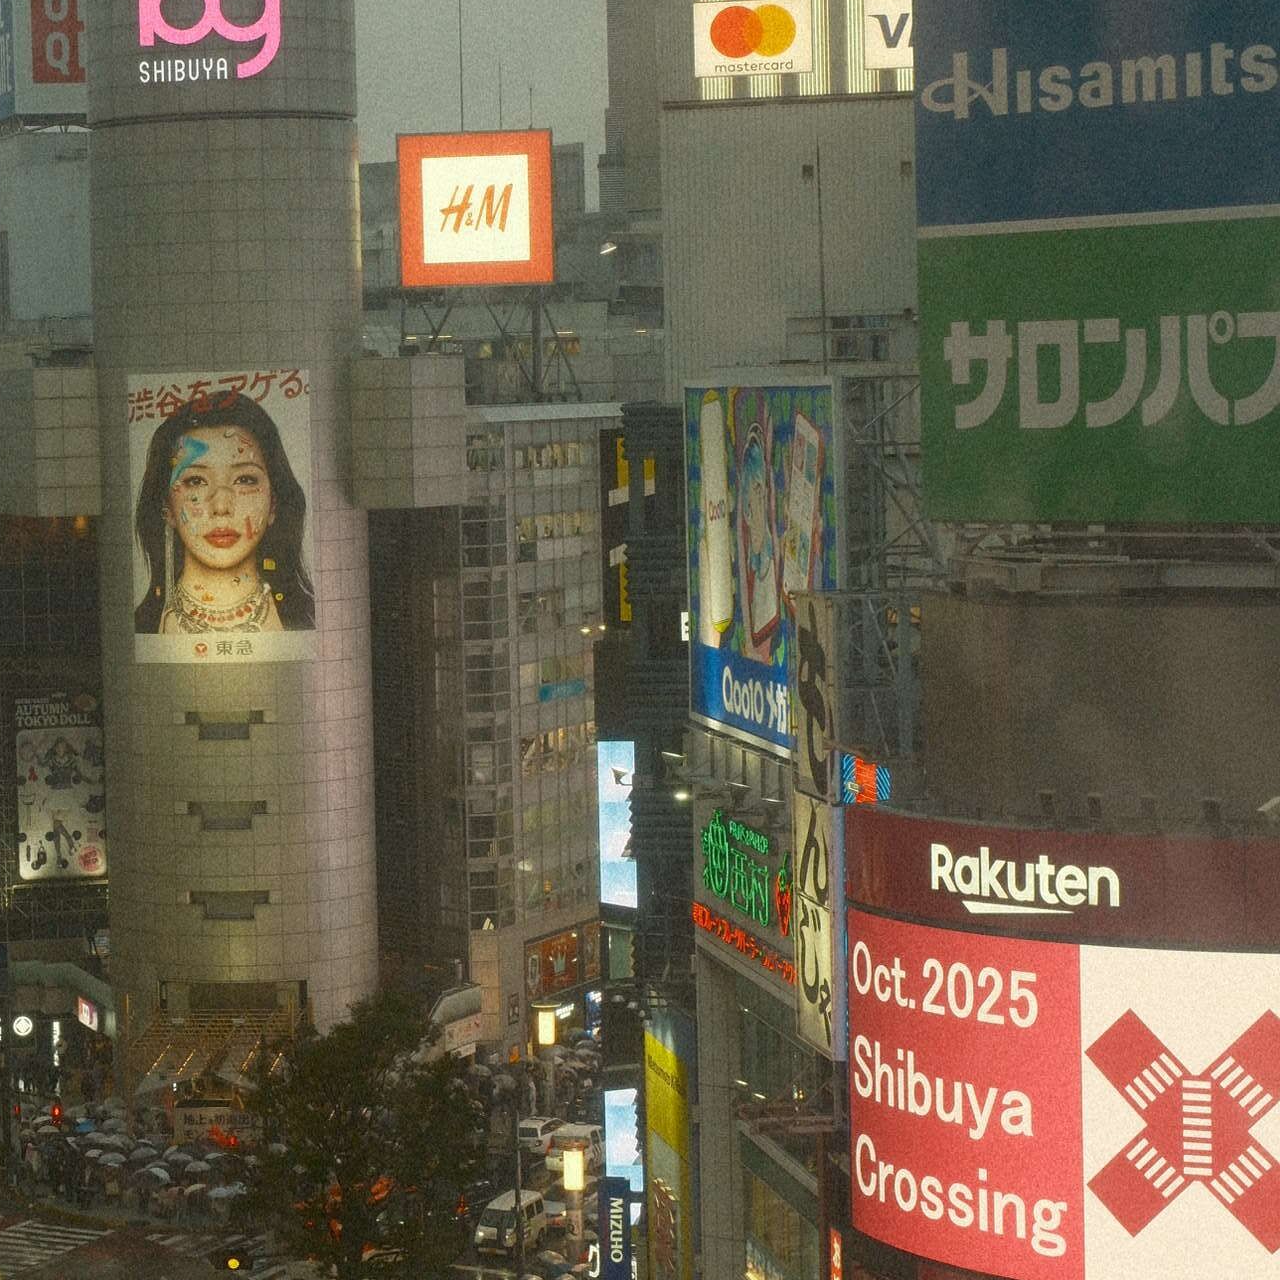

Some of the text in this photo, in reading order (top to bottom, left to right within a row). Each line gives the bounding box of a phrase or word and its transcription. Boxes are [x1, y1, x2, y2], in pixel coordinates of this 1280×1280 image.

[138, 57, 228, 84] SHIBUYA
[713, 58, 794, 76] mastercard
[439, 182, 513, 234] H&M
[127, 369, 311, 424] 渋谷をアゲる。
[215, 639, 255, 657] 東急
[16, 703, 69, 717] AUTUMN
[16, 714, 59, 727] TOKYO
[723, 665, 765, 725] Qoo10
[930, 843, 1120, 908] Rakuten
[852, 1040, 1034, 1147] Shibuya
[853, 1131, 1069, 1257] Crossing
[609, 1197, 624, 1264] MIZUHO
